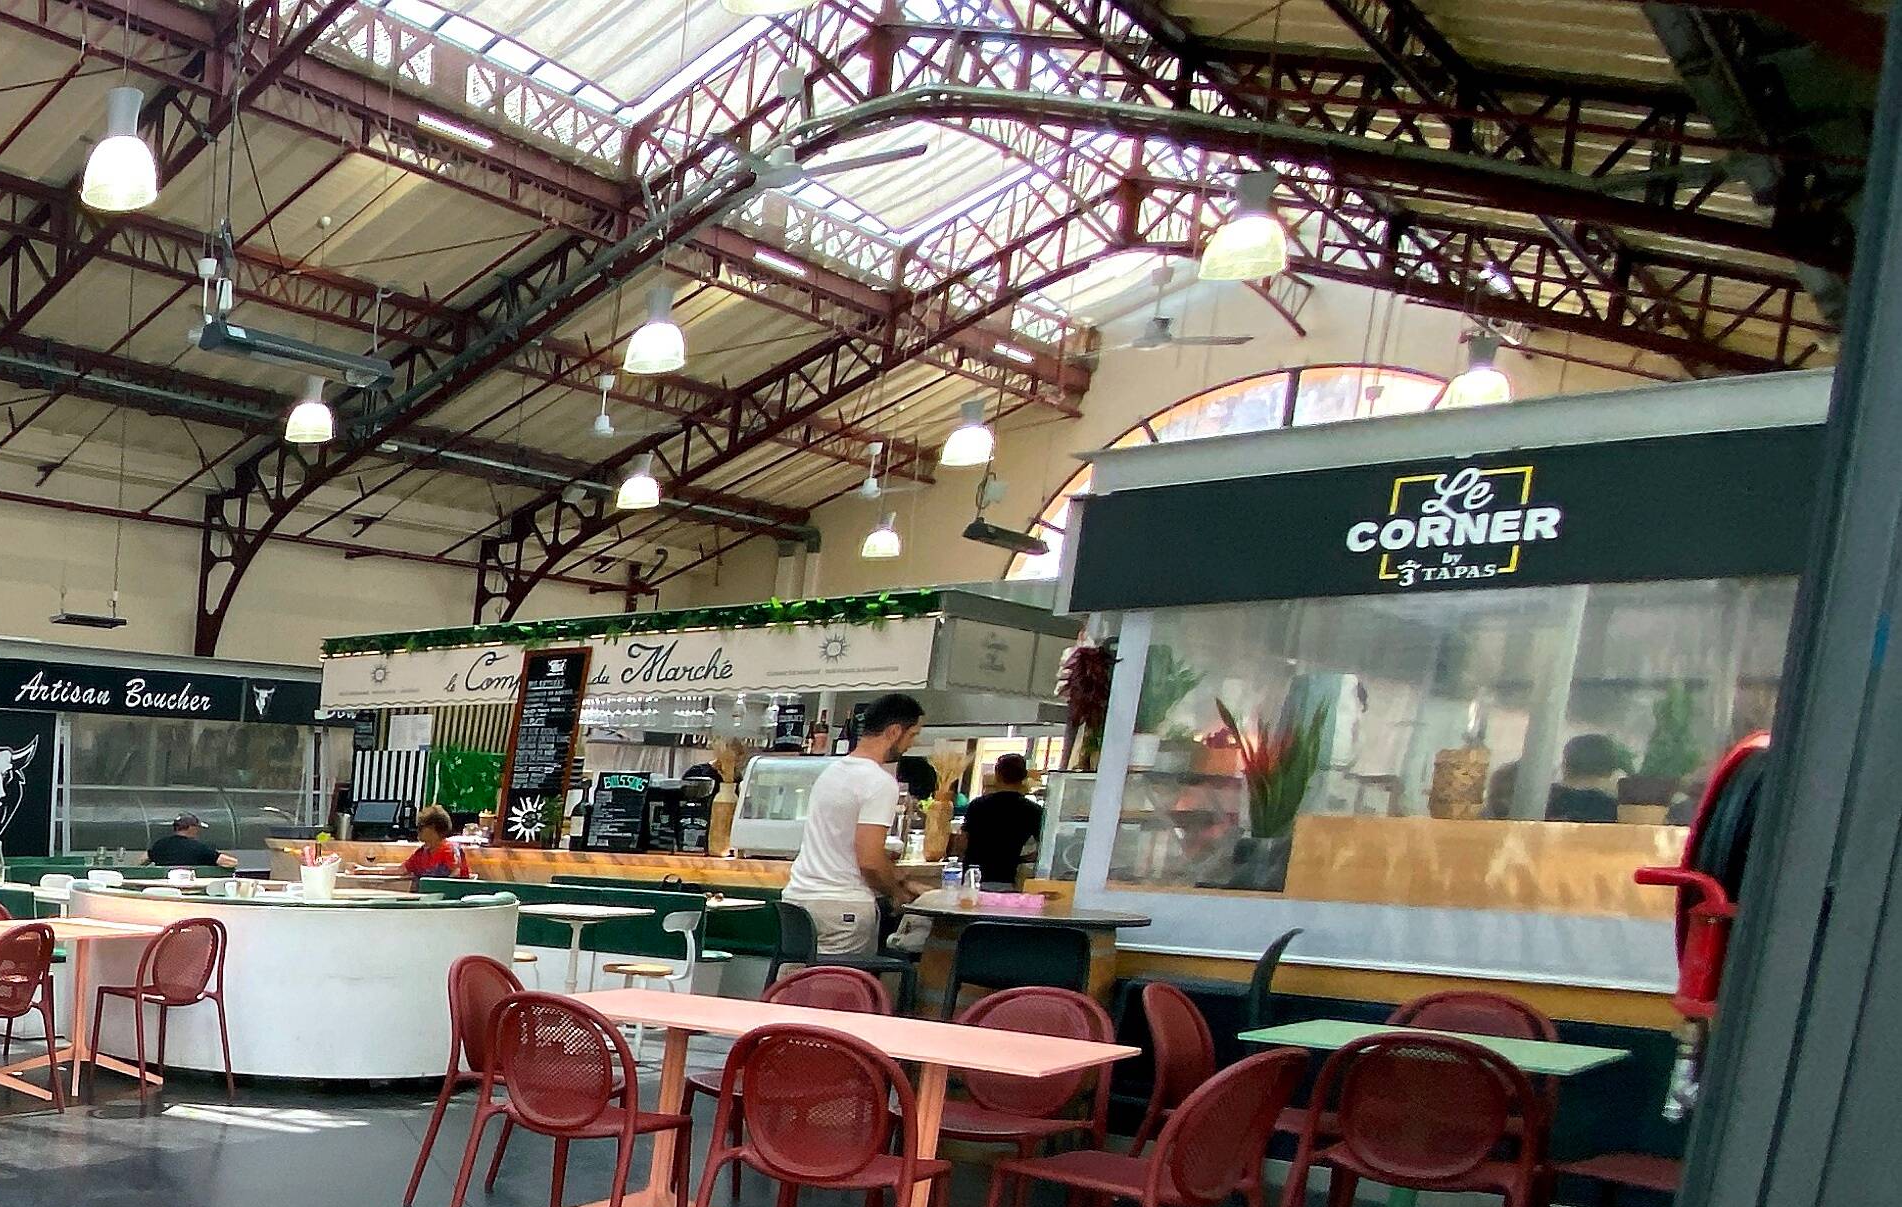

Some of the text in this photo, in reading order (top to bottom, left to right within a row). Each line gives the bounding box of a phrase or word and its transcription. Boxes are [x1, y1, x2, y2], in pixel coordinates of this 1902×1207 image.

[1422, 467, 1494, 518] Le
[1346, 506, 1561, 552] CORNER
[1421, 564, 1497, 582] TAPAS
[1442, 552, 1462, 566] by
[589, 664, 610, 686] du
[621, 640, 733, 684] Marché
[15, 670, 211, 711] Artisan Boucher
